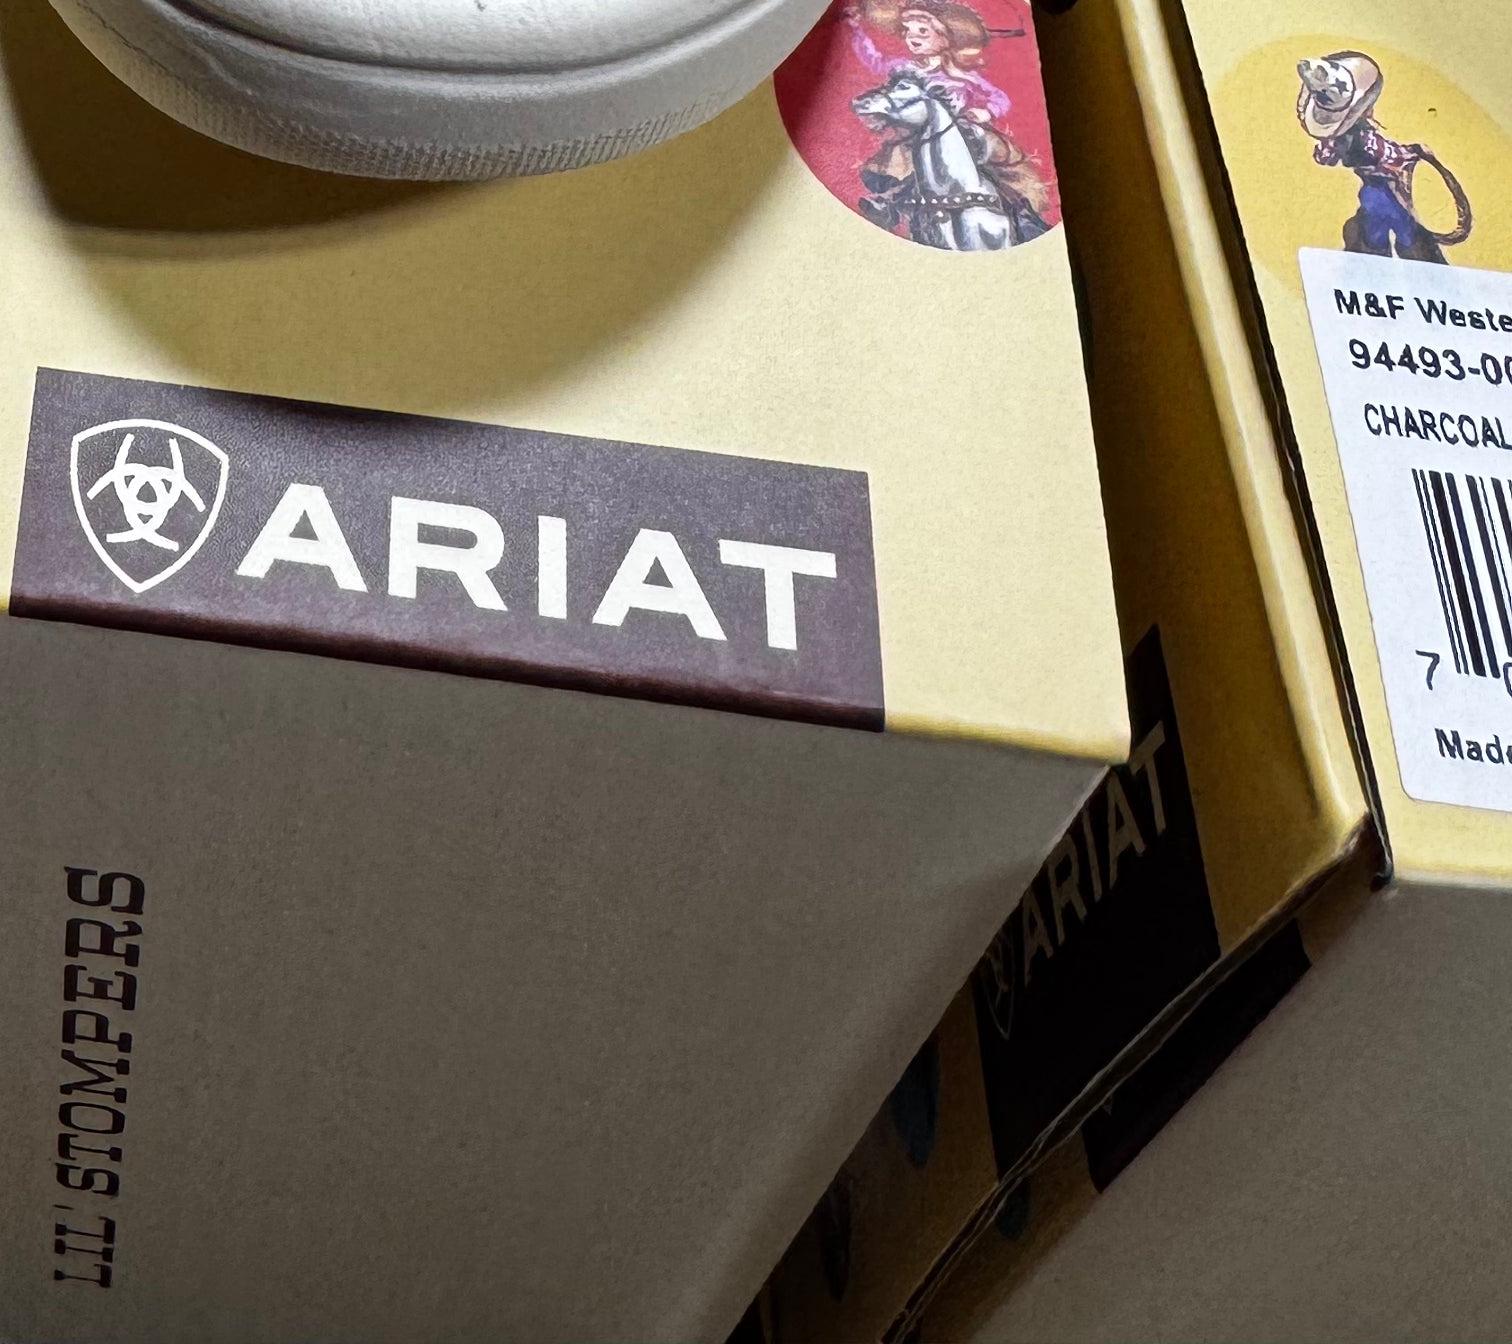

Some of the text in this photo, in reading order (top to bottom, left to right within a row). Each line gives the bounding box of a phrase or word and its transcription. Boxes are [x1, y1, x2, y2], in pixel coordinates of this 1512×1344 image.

[1333, 288, 1405, 320] M&F
[1363, 403, 1512, 451] CHARCOAL
[236, 483, 838, 652] ARIAT
[1415, 649, 1441, 691] 7
[1024, 720, 1167, 989] ARIAT
[53, 865, 146, 1290] LIL' STOMPERS
